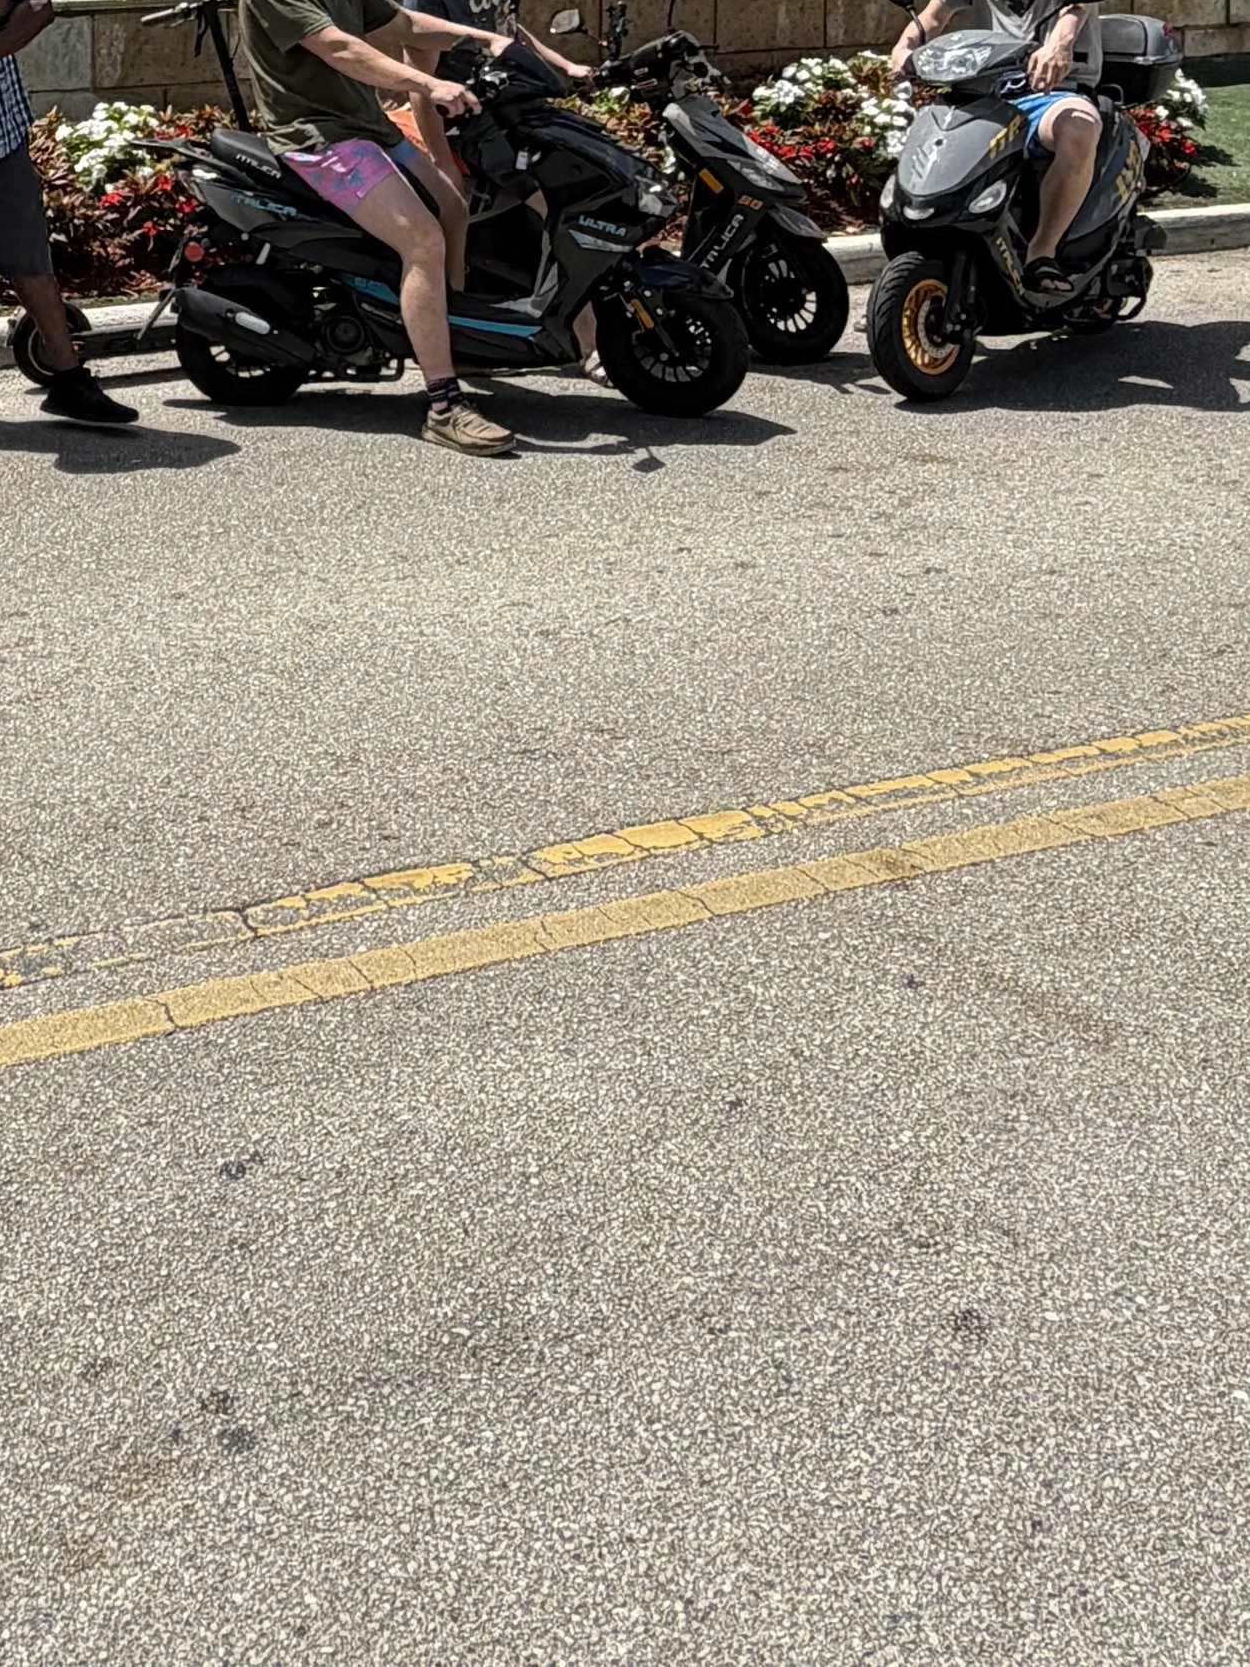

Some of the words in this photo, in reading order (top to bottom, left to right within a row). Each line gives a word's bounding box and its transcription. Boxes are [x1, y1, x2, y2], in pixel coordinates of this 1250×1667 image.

[236, 153, 282, 179] ITALICA
[230, 194, 298, 217] ITALICA
[578, 214, 627, 237] ULTRA
[700, 213, 745, 269] TALICA
